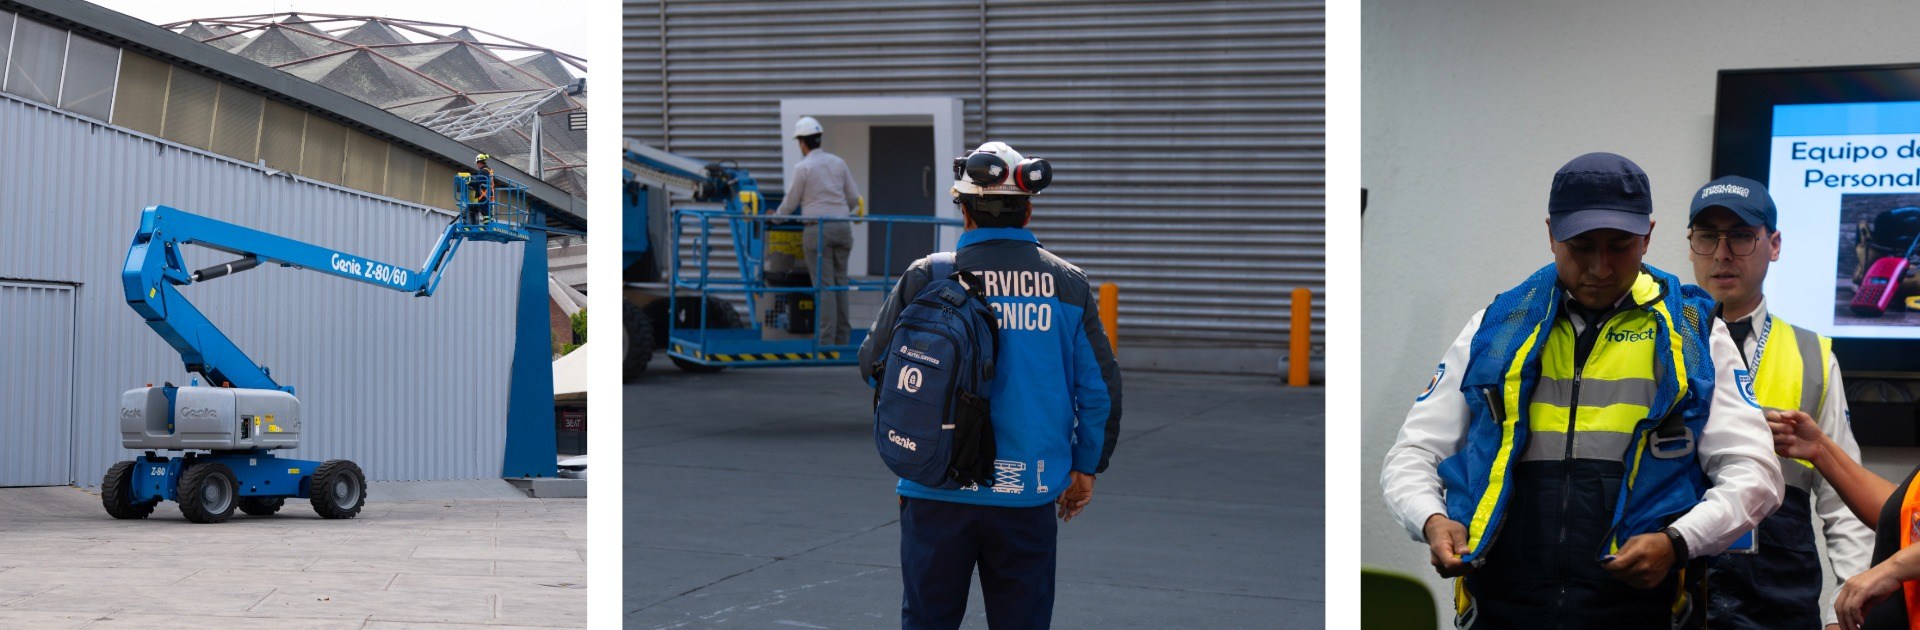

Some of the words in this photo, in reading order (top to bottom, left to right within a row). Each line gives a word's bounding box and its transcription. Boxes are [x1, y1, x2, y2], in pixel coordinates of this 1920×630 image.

[1791, 141, 1888, 163] Equipo
[1804, 168, 1920, 188] Personal
[331, 253, 362, 276] Genie
[364, 261, 408, 287] Z-80/60
[952, 270, 1055, 298] RVICIO
[988, 302, 1052, 331] CNICO
[1749, 321, 1771, 379] BRIGADISTA
[897, 364, 923, 393] 10
[180, 406, 218, 419] Genie
[888, 429, 917, 452] Genie
[151, 466, 166, 476] Z-80
